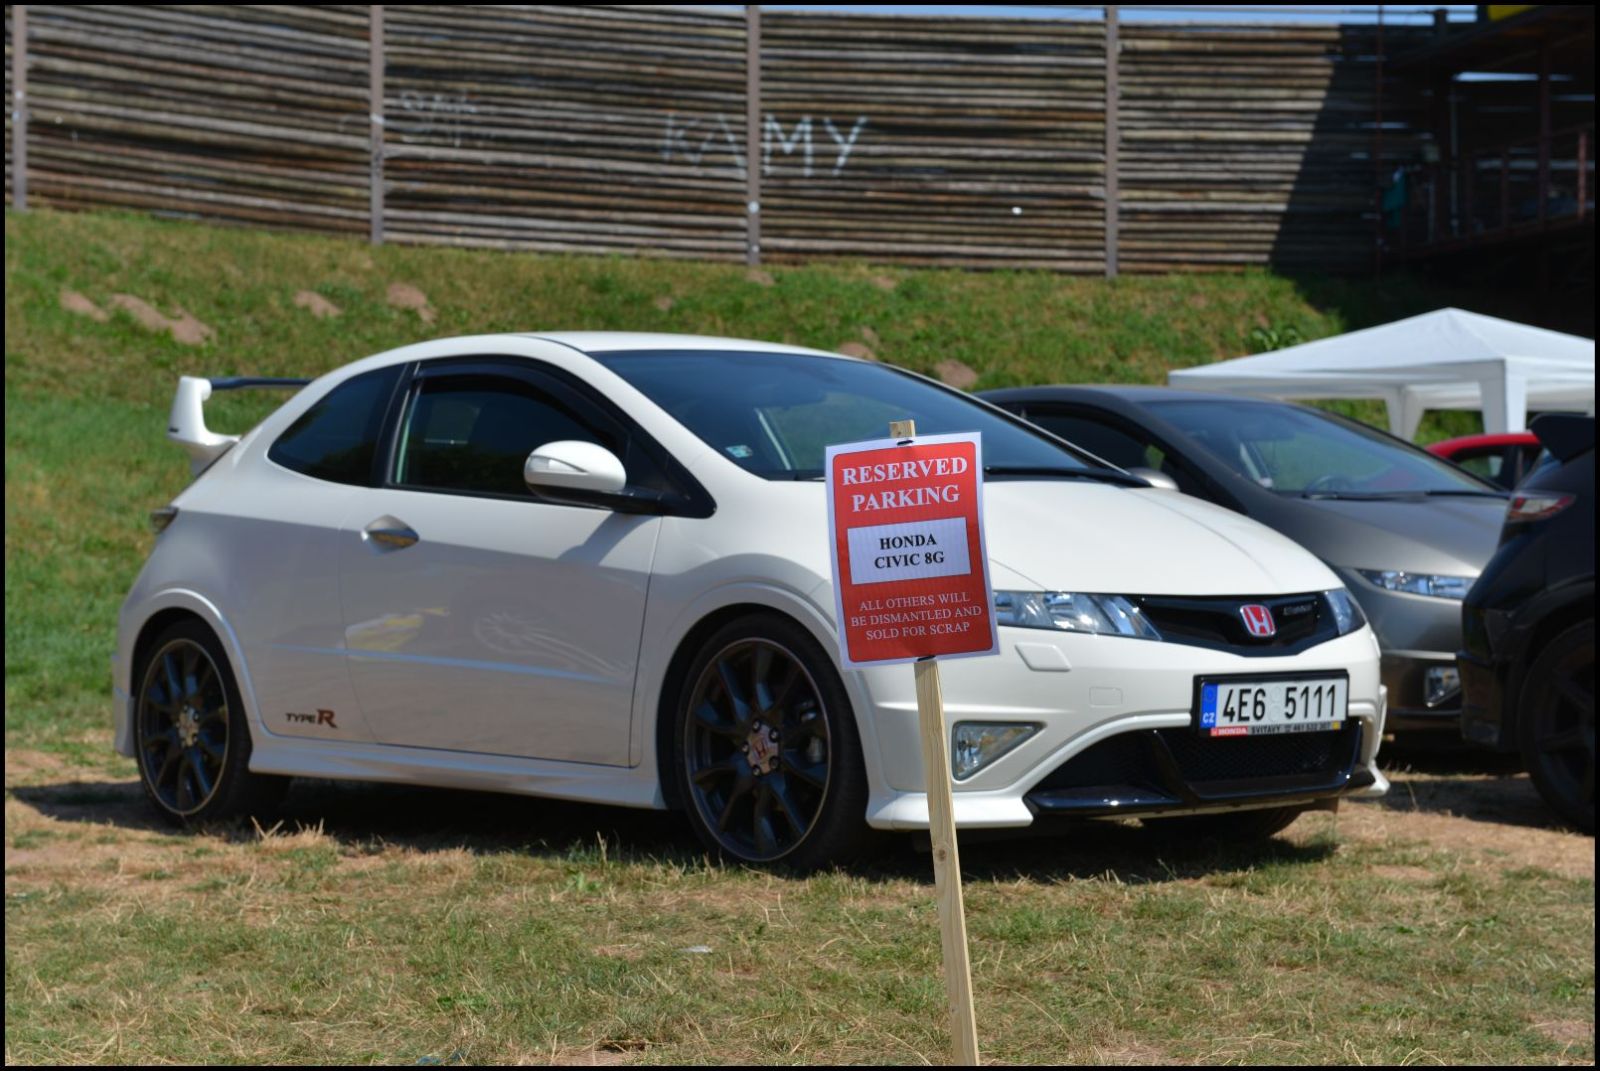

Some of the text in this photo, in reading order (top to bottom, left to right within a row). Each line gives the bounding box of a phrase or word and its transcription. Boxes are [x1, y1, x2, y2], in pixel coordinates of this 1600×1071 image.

[842, 456, 968, 486] RESERVED
[851, 484, 960, 513] PARKING
[879, 533, 937, 550] HONDA
[874, 550, 945, 569] CIVIC 8G
[859, 592, 970, 612] ALL OTHERS WILL
[851, 605, 982, 627] BE DISMANTLED AND
[865, 622, 970, 641] SOLD FOR SCRAP
[1222, 684, 1336, 723] 4E6 5111
[286, 708, 338, 729] TYPE R
[1202, 712, 1215, 723] CZ
[1217, 727, 1248, 736] HONDA
